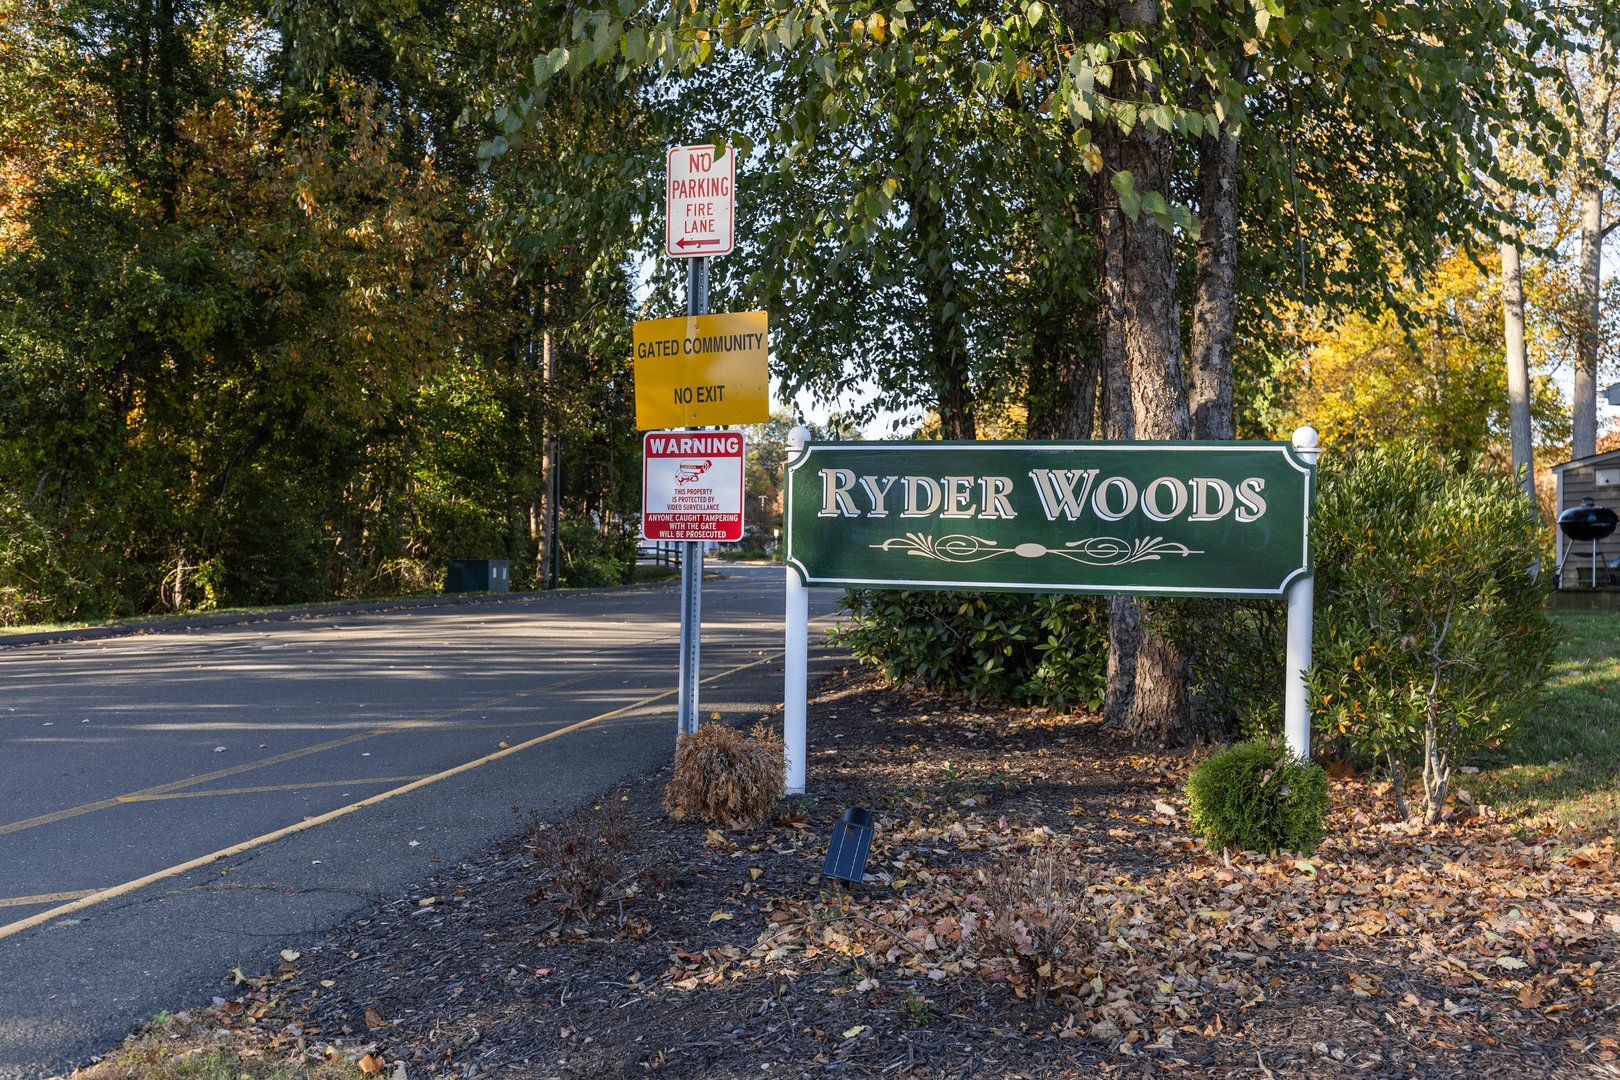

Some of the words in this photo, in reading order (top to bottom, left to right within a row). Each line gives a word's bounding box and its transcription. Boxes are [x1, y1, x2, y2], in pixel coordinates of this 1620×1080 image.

[689, 152, 712, 173] NO
[672, 176, 729, 200] PARKING
[686, 202, 714, 217] FIRE
[684, 219, 715, 234] LANE
[637, 339, 680, 359] GATED
[683, 333, 763, 355] COMMUNITY
[674, 387, 693, 404] NO
[696, 385, 725, 403] EXIT
[650, 438, 739, 454] WARNING
[817, 467, 1018, 519] RYDER
[1028, 467, 1268, 523] WOODS
[648, 514, 673, 522] ANYONE
[675, 514, 700, 522] CAUGHT
[702, 514, 738, 522] TAMPERING
[669, 522, 685, 530] WITH
[687, 522, 699, 530] THE
[700, 522, 717, 530] GATE
[659, 530, 674, 538] WILL
[676, 530, 684, 538] BE
[685, 530, 727, 538] PROSECUTED
